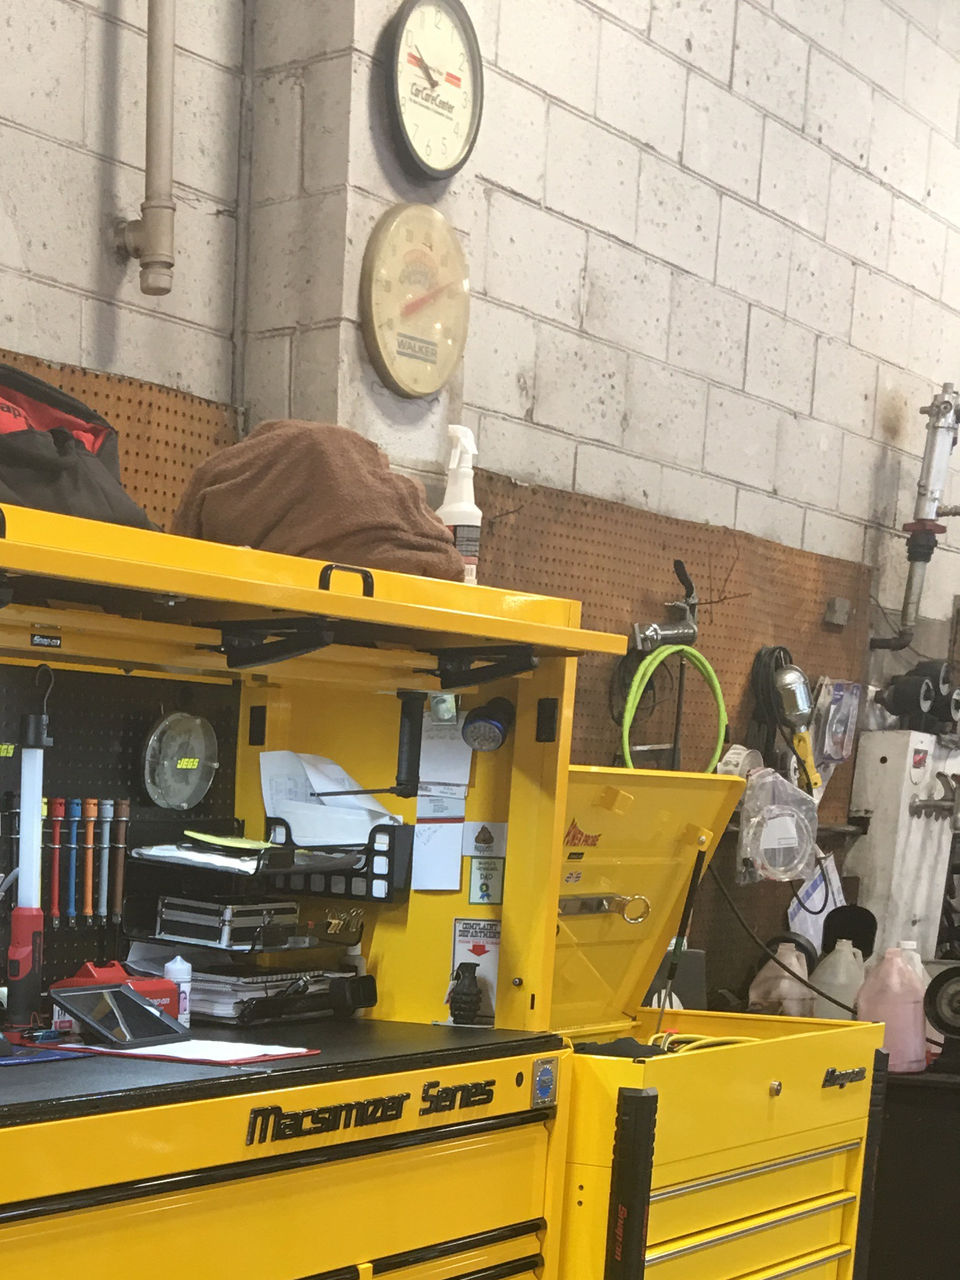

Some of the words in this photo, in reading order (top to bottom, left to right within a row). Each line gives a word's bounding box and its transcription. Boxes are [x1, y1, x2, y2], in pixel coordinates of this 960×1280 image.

[425, 138, 432, 157] 6
[441, 136, 448, 156] 5
[396, 339, 438, 360] WALKER
[33, 635, 61, 646] Snap-on
[176, 757, 200, 769] JEGS
[458, 930, 501, 939] DEPARTMENT
[462, 922, 498, 930] COMPLAINT
[245, 1092, 411, 1147] Macsimizer
[419, 1079, 496, 1116] Series
[614, 1203, 628, 1262] Snap-on
